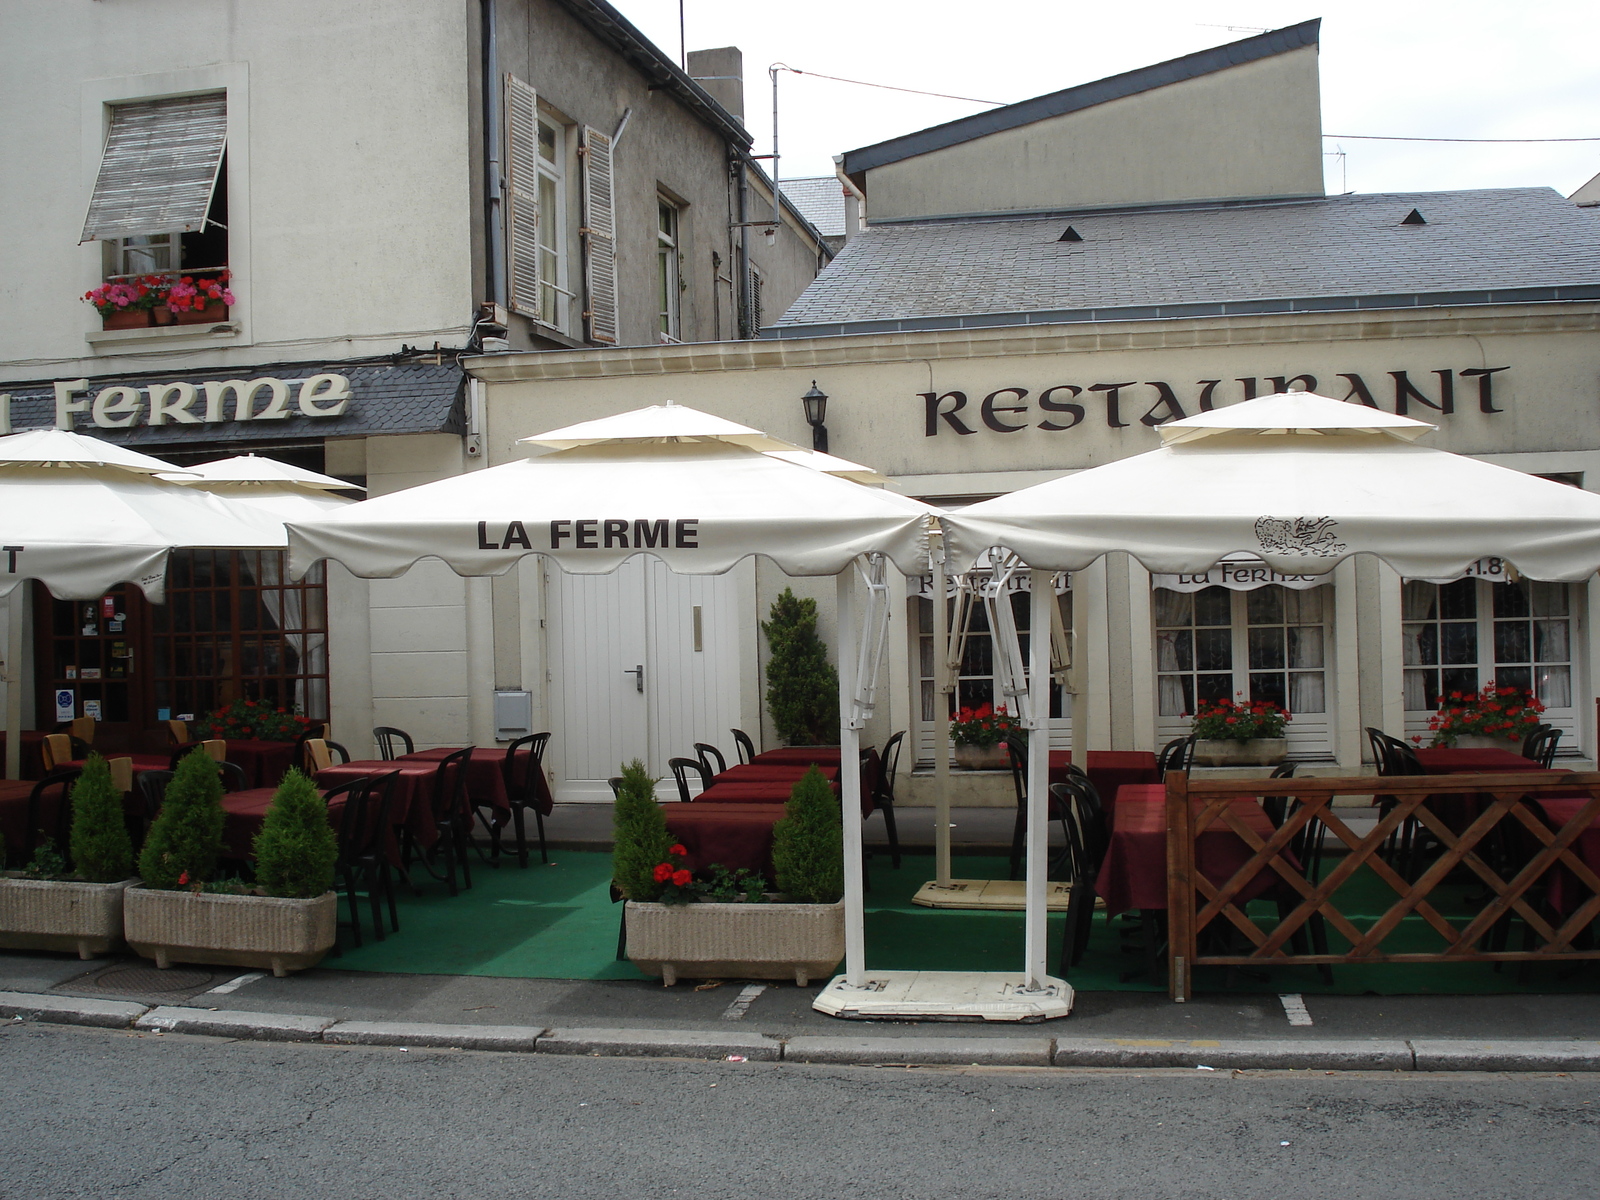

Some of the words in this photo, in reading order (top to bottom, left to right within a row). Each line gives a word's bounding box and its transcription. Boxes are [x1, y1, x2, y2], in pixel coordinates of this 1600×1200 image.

[478, 520, 533, 550] LA
[550, 519, 699, 549] FERME
[918, 571, 1072, 593] Retart
